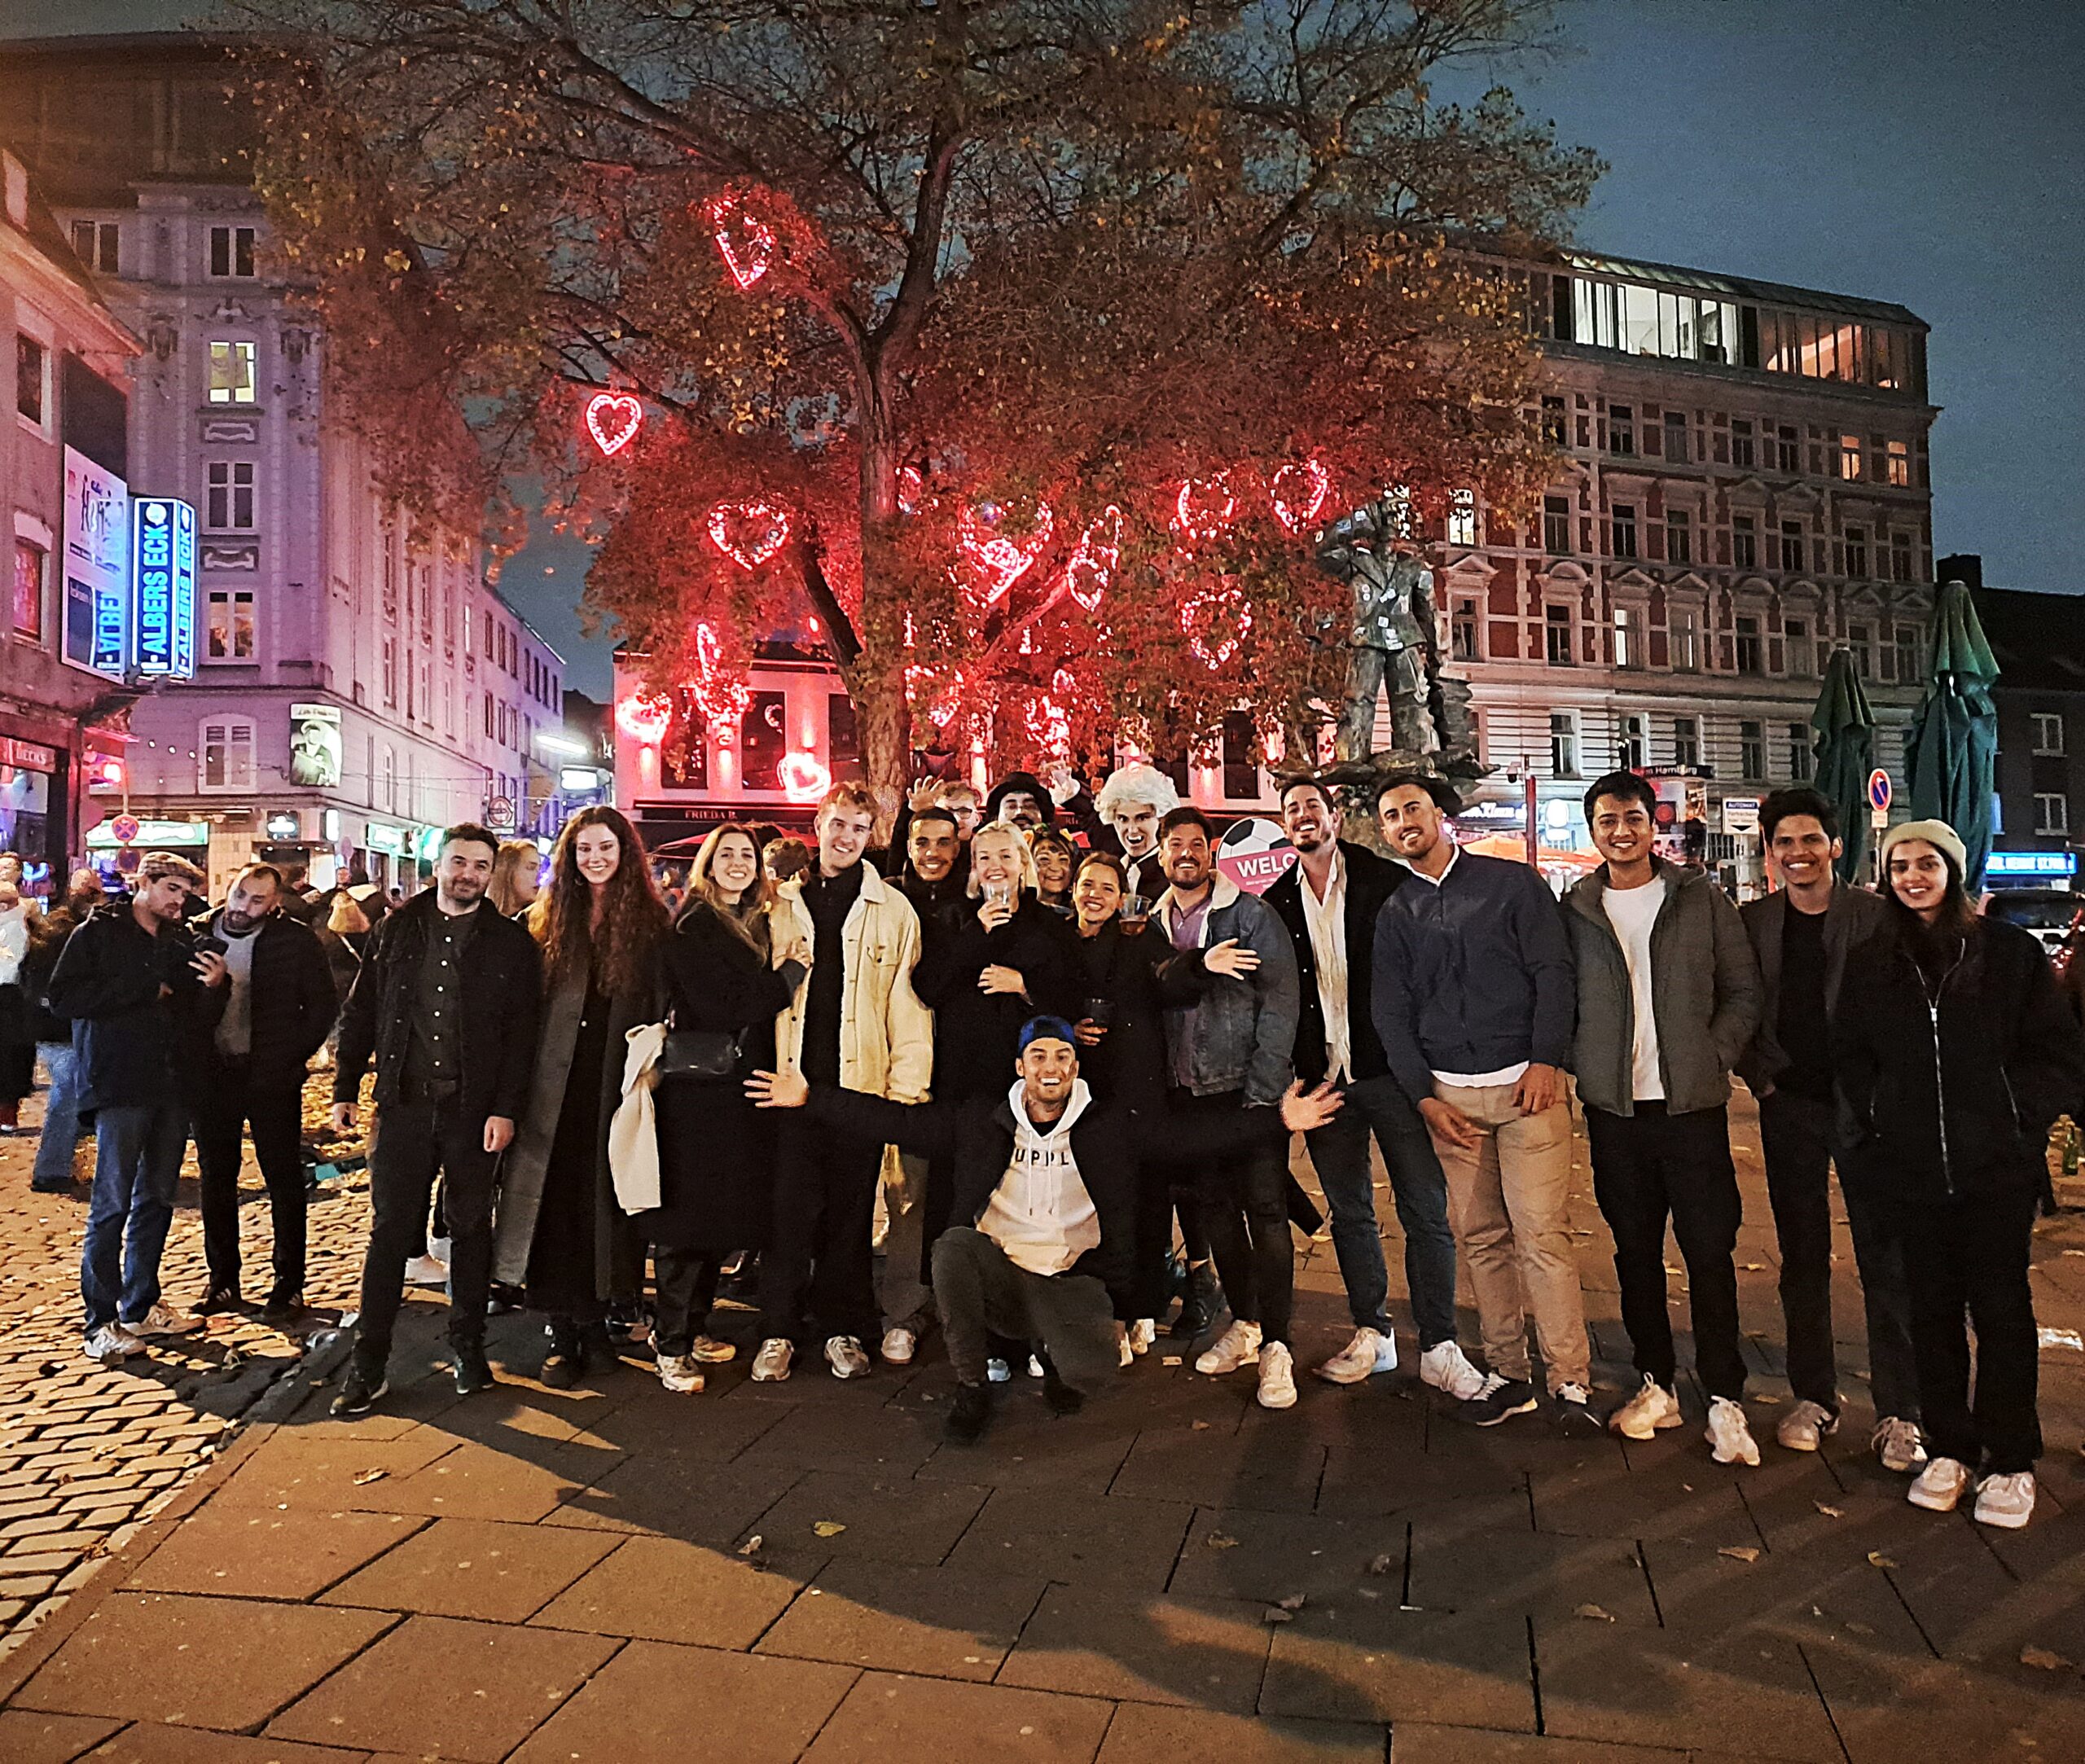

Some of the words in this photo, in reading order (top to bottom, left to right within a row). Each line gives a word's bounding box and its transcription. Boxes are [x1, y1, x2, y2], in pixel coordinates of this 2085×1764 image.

[143, 524, 169, 566] ECK
[143, 571, 169, 655] ALBERS
[685, 810, 726, 819] FRIEDA
[1015, 1147, 1069, 1167] UPPL
